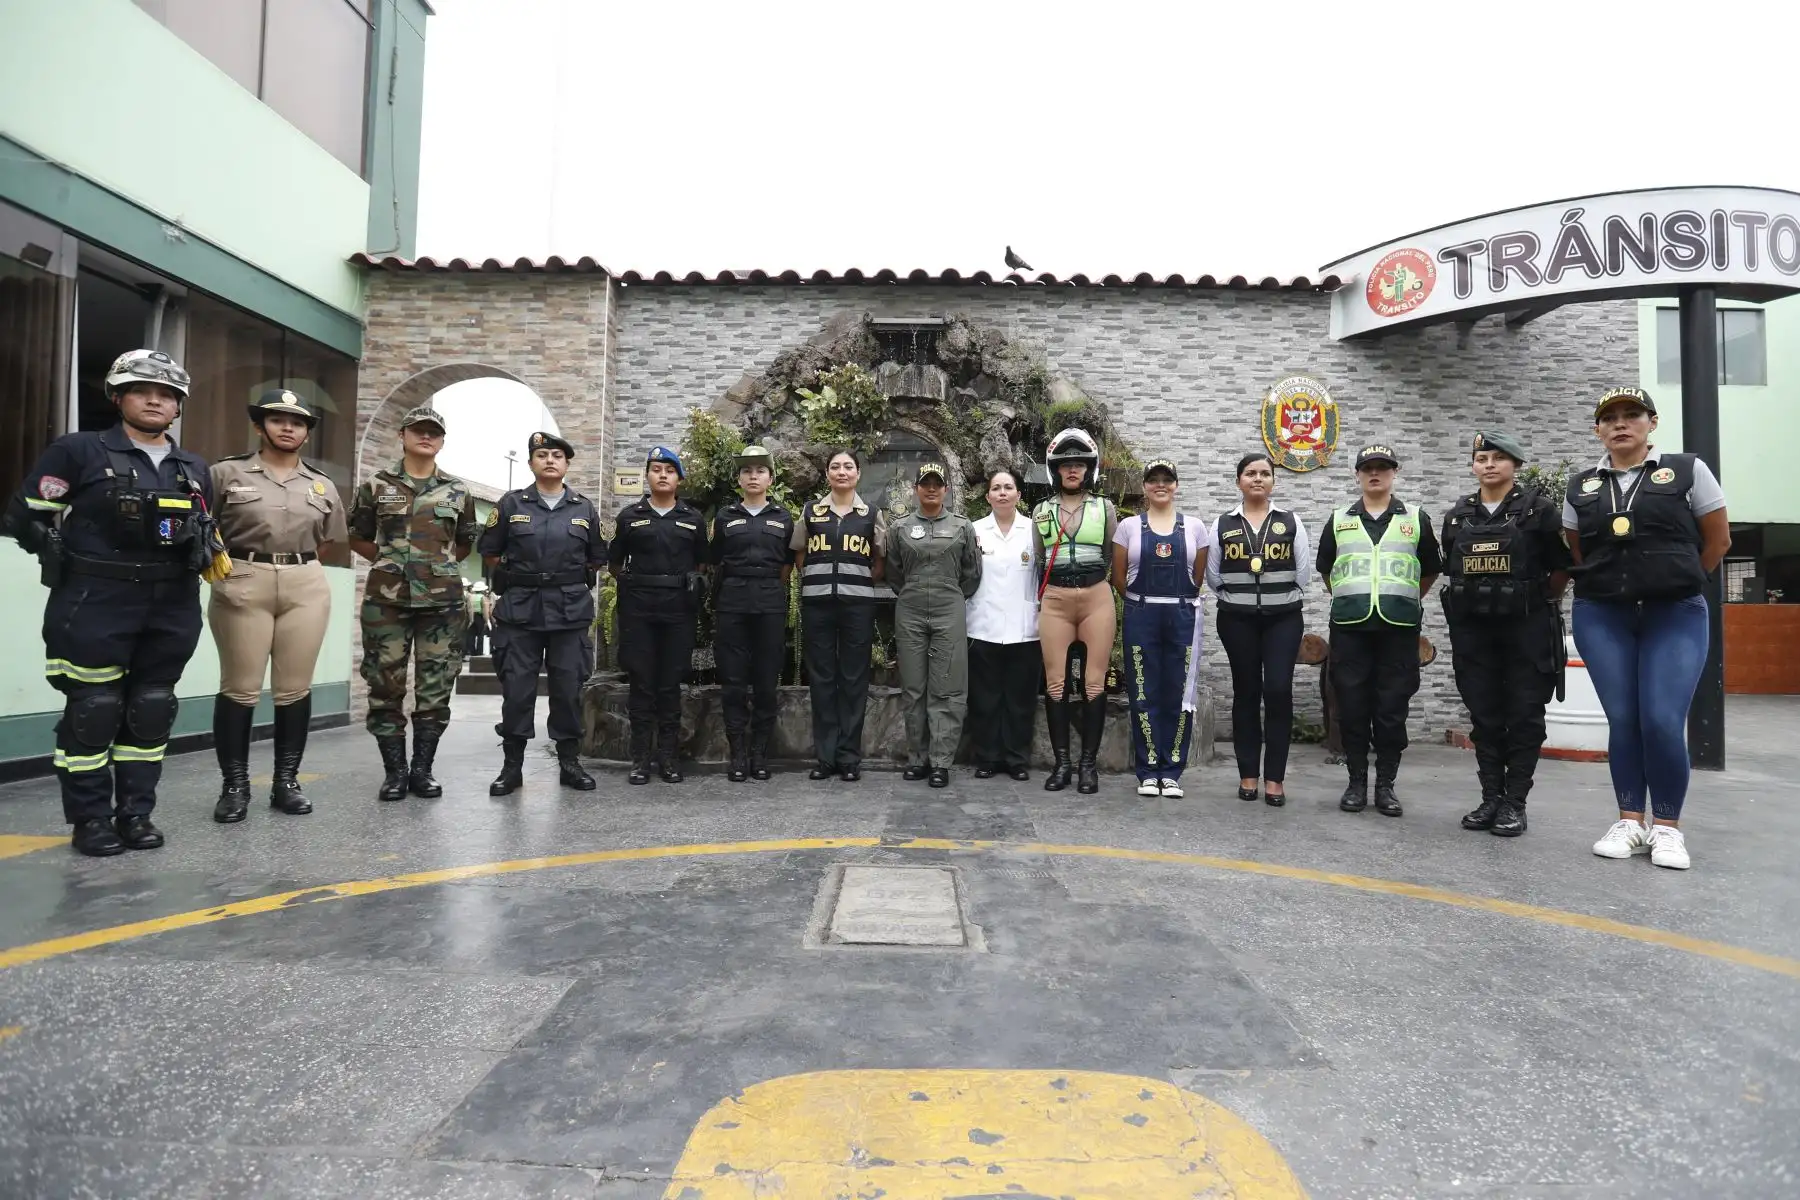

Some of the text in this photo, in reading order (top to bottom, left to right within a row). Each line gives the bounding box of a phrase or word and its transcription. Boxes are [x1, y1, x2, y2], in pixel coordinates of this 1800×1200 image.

[1438, 208, 1800, 299] TRÁNSITO
[1599, 386, 1645, 406] POLICIA
[1361, 445, 1392, 457] POLICIA
[919, 463, 945, 478] POLICIA
[1147, 459, 1174, 470] POLICIA
[1464, 556, 1508, 572] POLICIA
[1132, 645, 1146, 701] POLICIA
